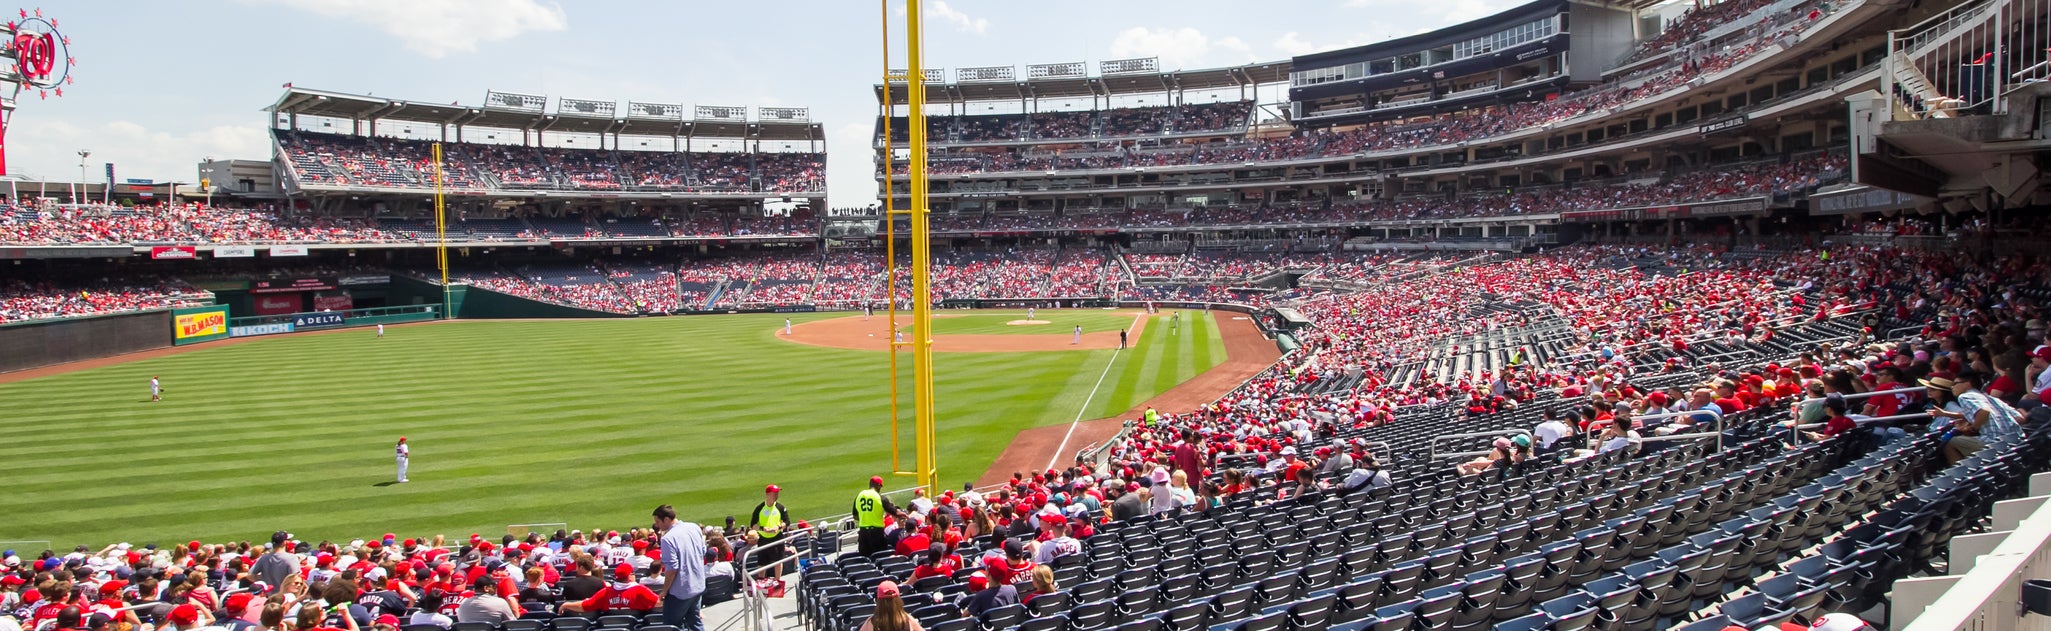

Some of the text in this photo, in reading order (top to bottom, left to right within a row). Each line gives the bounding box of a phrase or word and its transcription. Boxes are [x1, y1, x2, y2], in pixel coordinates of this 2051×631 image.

[308, 315, 341, 324] DELTA
[248, 323, 288, 336] KOCH
[860, 498, 874, 512] 29
[359, 594, 384, 605] HARPER
